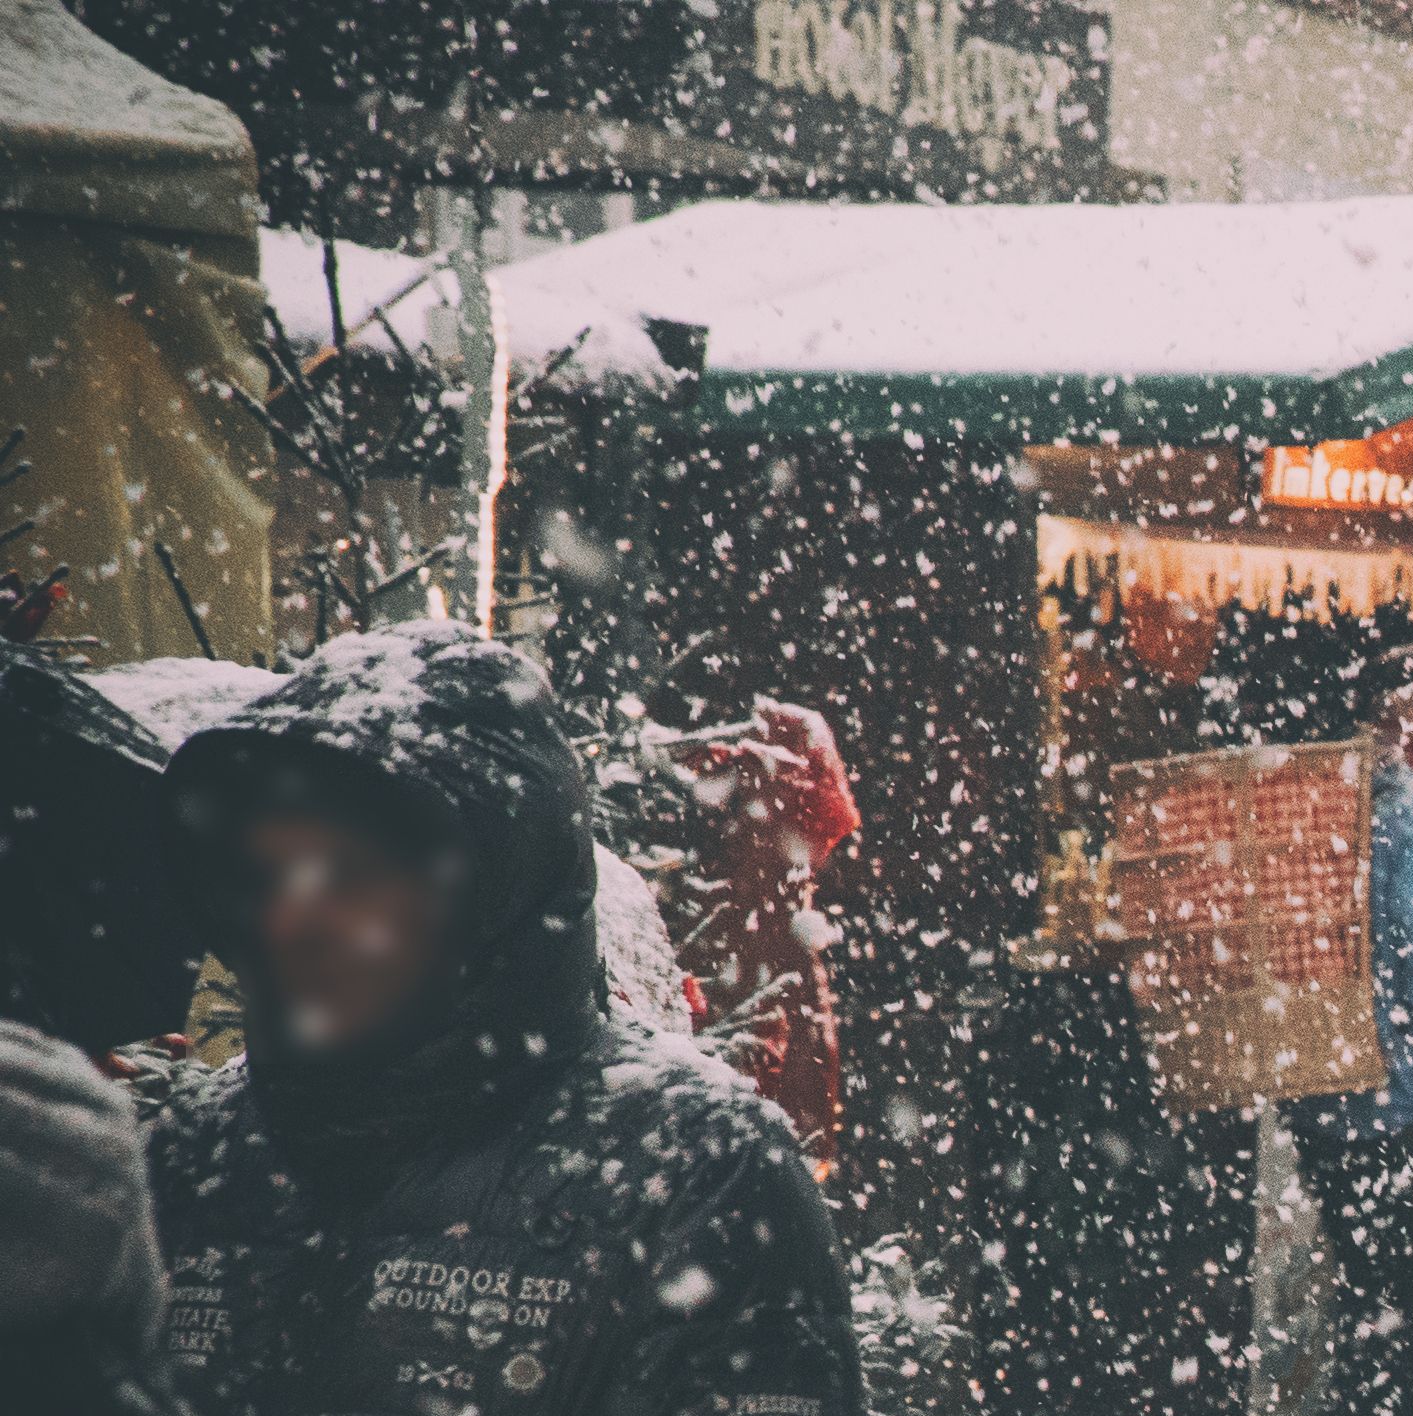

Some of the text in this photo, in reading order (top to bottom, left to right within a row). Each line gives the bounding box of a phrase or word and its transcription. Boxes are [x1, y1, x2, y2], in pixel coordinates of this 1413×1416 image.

[374, 1258, 575, 1304] OUTDOOR EXP.
[376, 1284, 551, 1328] FOUNDON
